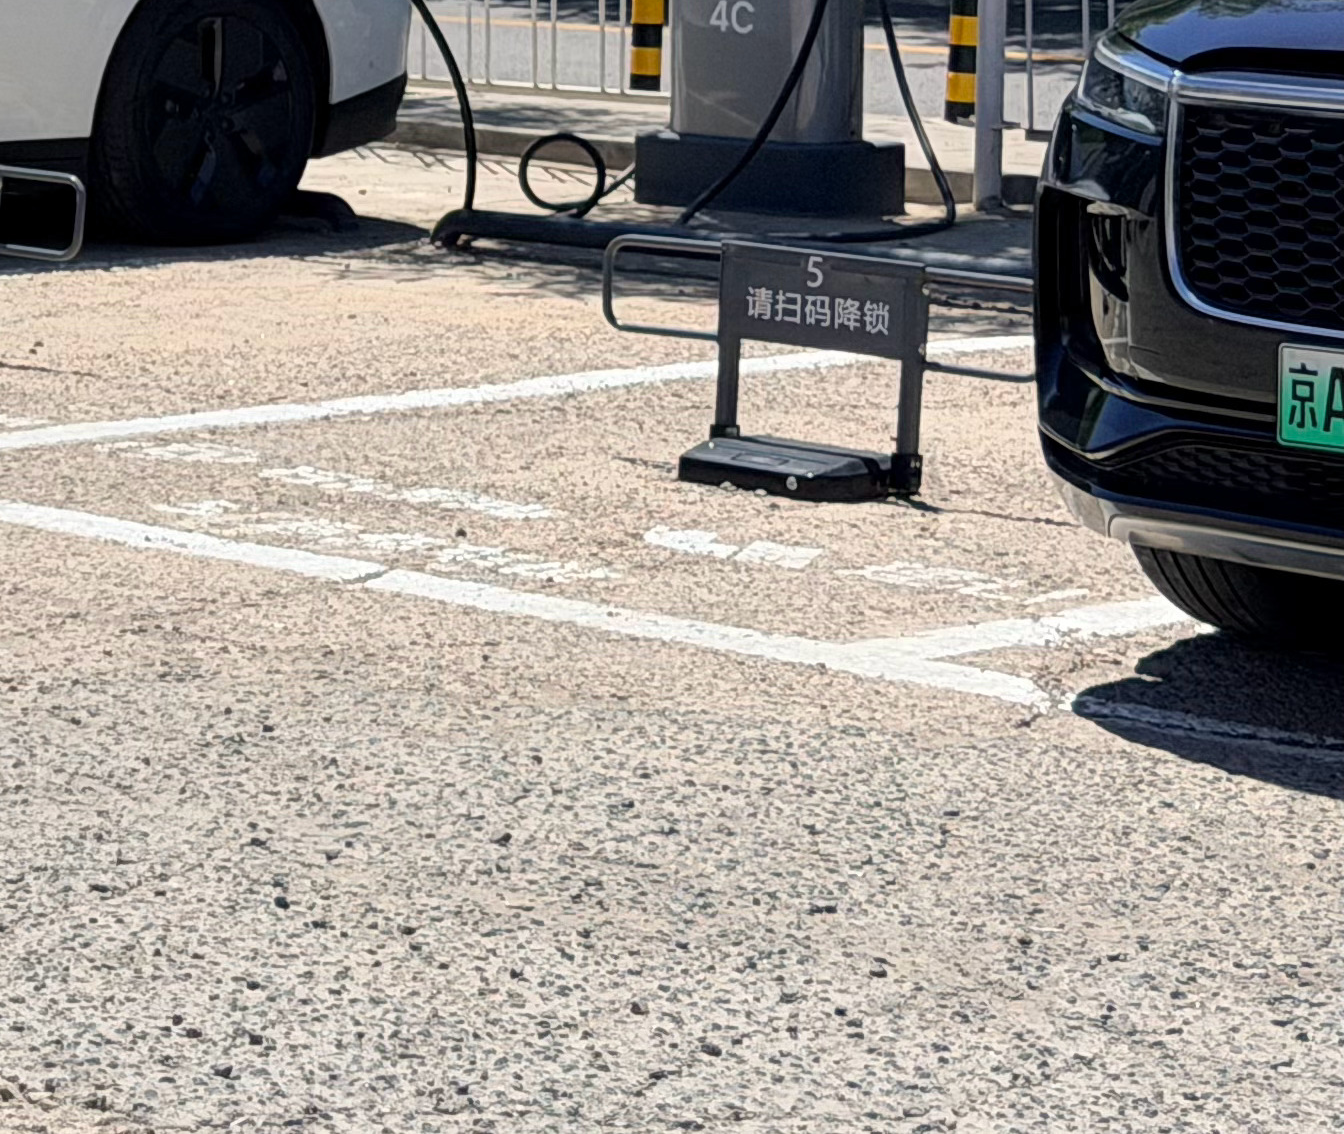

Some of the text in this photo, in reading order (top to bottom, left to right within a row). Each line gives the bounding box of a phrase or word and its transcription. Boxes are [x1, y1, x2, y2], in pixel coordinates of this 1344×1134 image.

[709, 0, 755, 34] 4C
[806, 256, 824, 288] 5
[745, 286, 890, 336] 请扫码降锁
